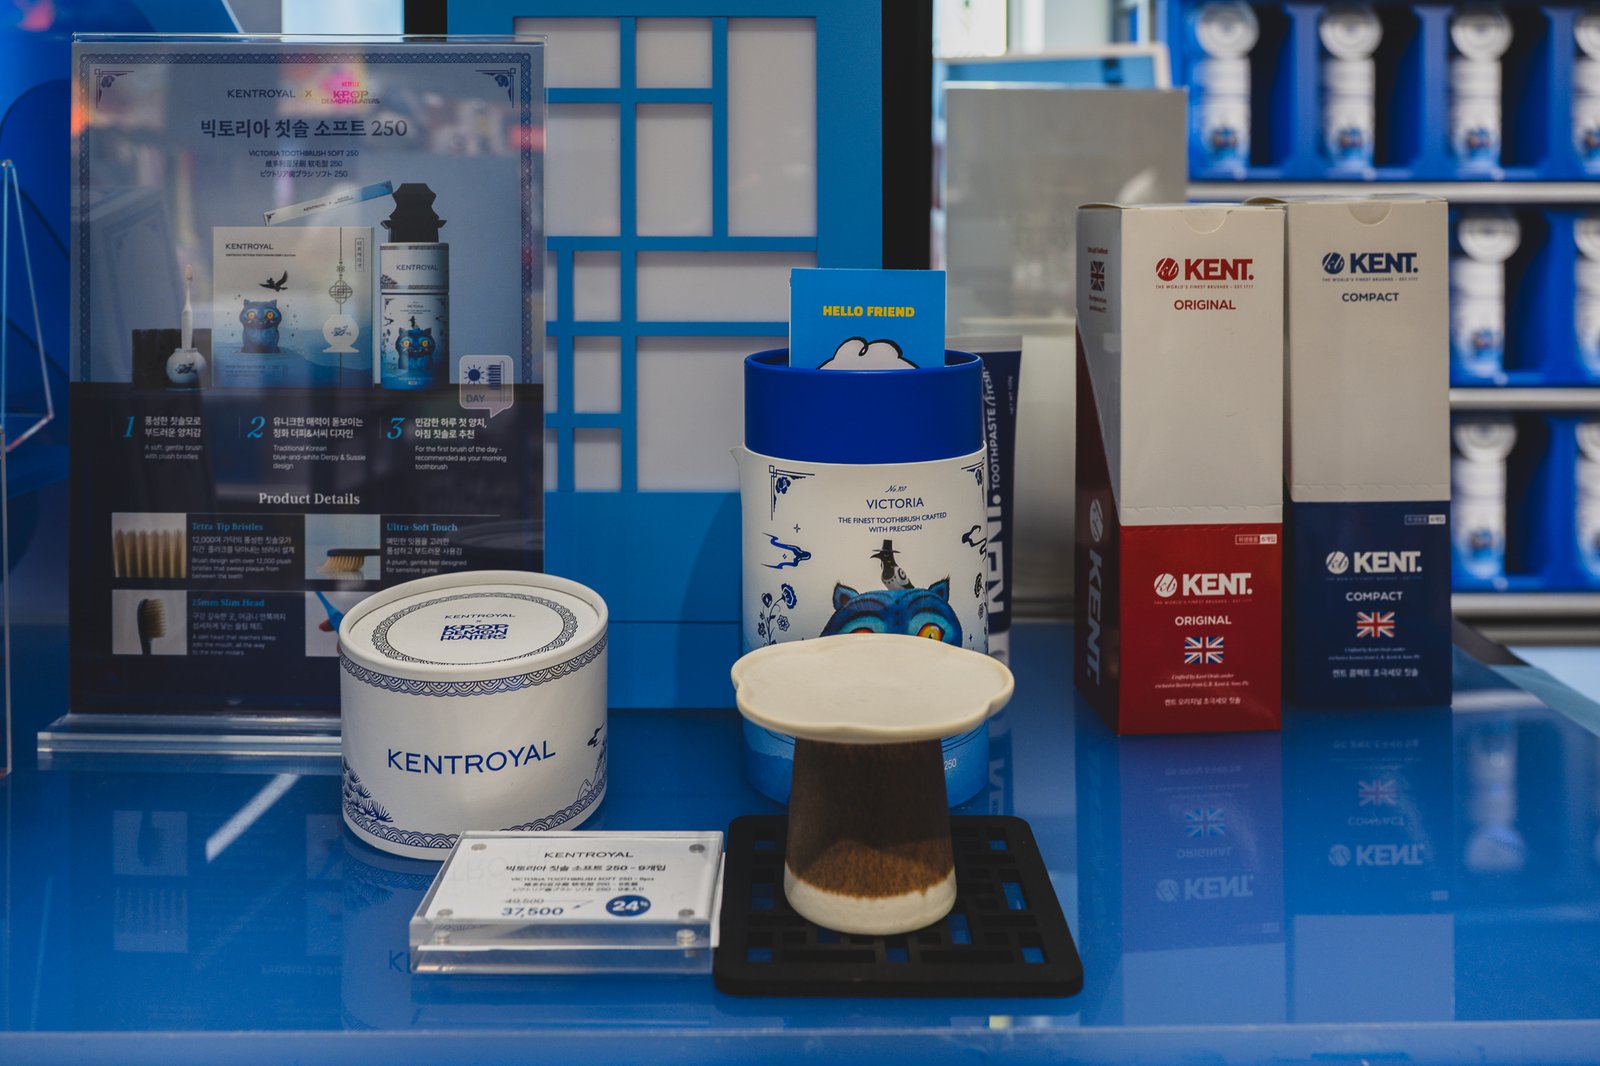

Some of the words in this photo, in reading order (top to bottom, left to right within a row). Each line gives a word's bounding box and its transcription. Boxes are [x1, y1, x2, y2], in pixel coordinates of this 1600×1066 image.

[227, 89, 296, 99] KENTROYAL
[200, 119, 270, 138] 빅토리아
[275, 120, 310, 138] 칫솔
[314, 120, 367, 137] 소프트
[371, 120, 408, 137] 250
[248, 149, 280, 157] VICTORIA
[281, 149, 327, 157] TOOTHBRUSH
[327, 149, 345, 157] SOFT
[345, 149, 359, 157] 250
[329, 160, 343, 168] 250
[334, 170, 348, 178] 250
[225, 242, 274, 250] KENTROYAL
[1349, 252, 1419, 274] KENT.
[1184, 258, 1255, 281] KENT.
[1342, 292, 1400, 303] COMPACT
[1173, 299, 1237, 311] ORIGINAL
[823, 305, 863, 317] HELLO
[867, 306, 915, 318] FRIEND
[466, 394, 485, 403] DAY
[145, 416, 169, 426] 풍성한
[170, 416, 201, 426] 칫솔모로
[273, 417, 305, 427] 유니크한
[306, 417, 330, 427] 매력이
[331, 417, 364, 427] 돋보이는
[415, 417, 440, 428] 민감한
[440, 417, 458, 428] 하루
[458, 417, 468, 428] 첫
[468, 417, 488, 429] 양치,
[122, 415, 136, 438] 1
[246, 415, 267, 440] 2
[386, 416, 406, 440] 3
[145, 428, 176, 438] 부드러운
[177, 428, 201, 438] 양치감
[273, 429, 290, 439] 청화
[329, 429, 354, 439] 디자인
[415, 429, 432, 439] 아침
[432, 429, 457, 439] 칫솔로
[458, 429, 476, 439] 추천
[273, 444, 305, 452] Traditional
[305, 444, 328, 452] Korean
[486, 445, 498, 454] day
[986, 409, 1001, 490] TOOTHPASTE
[320, 454, 339, 462] Derpy
[415, 454, 459, 462] recommended
[467, 455, 482, 463] your
[482, 454, 507, 463] morning
[273, 463, 294, 471] design
[415, 463, 449, 471] toothbrush
[258, 492, 311, 505] Product
[314, 492, 361, 505] Details
[865, 496, 925, 510] VICTORIA
[876, 515, 921, 524] TOOTHBRUSH
[921, 511, 947, 521] CRAFTED
[192, 522, 231, 533] Tetra-Tip
[231, 522, 264, 531] Bristles
[386, 522, 430, 532] Ultra-Soft
[430, 522, 459, 532] Touch
[889, 524, 923, 533] PRECISION
[407, 537, 429, 546] 잇몸을
[429, 537, 450, 546] 고려한
[387, 547, 414, 556] 풍성하고
[415, 547, 442, 556] 부드러운
[442, 547, 463, 556] 사용감
[440, 559, 468, 568] designed
[1353, 550, 1423, 574] KENT.
[1182, 572, 1253, 597] KENT.
[1345, 590, 1404, 602] COMPACT
[220, 598, 241, 607] Slim
[242, 598, 265, 607] Head
[1087, 548, 1103, 686] KENT.
[1174, 615, 1232, 627] ORIGINAL
[439, 634, 507, 642] HUNTERS
[1332, 668, 1347, 678] 켄트
[1373, 668, 1402, 678] 초극세모
[1404, 667, 1419, 677] 칫솔
[1178, 698, 1203, 706] 오리지널
[1204, 697, 1228, 705] 초극세모
[1229, 697, 1241, 705] 칫솔
[387, 740, 556, 775] KENTROYAL
[943, 758, 957, 770] 250
[544, 851, 634, 859] KENTROYAL
[505, 864, 547, 872] 빅토리아
[549, 864, 570, 872] 칫솔
[638, 864, 667, 872] 9개입
[611, 900, 649, 912] 24%
[501, 907, 564, 918] 37,500
